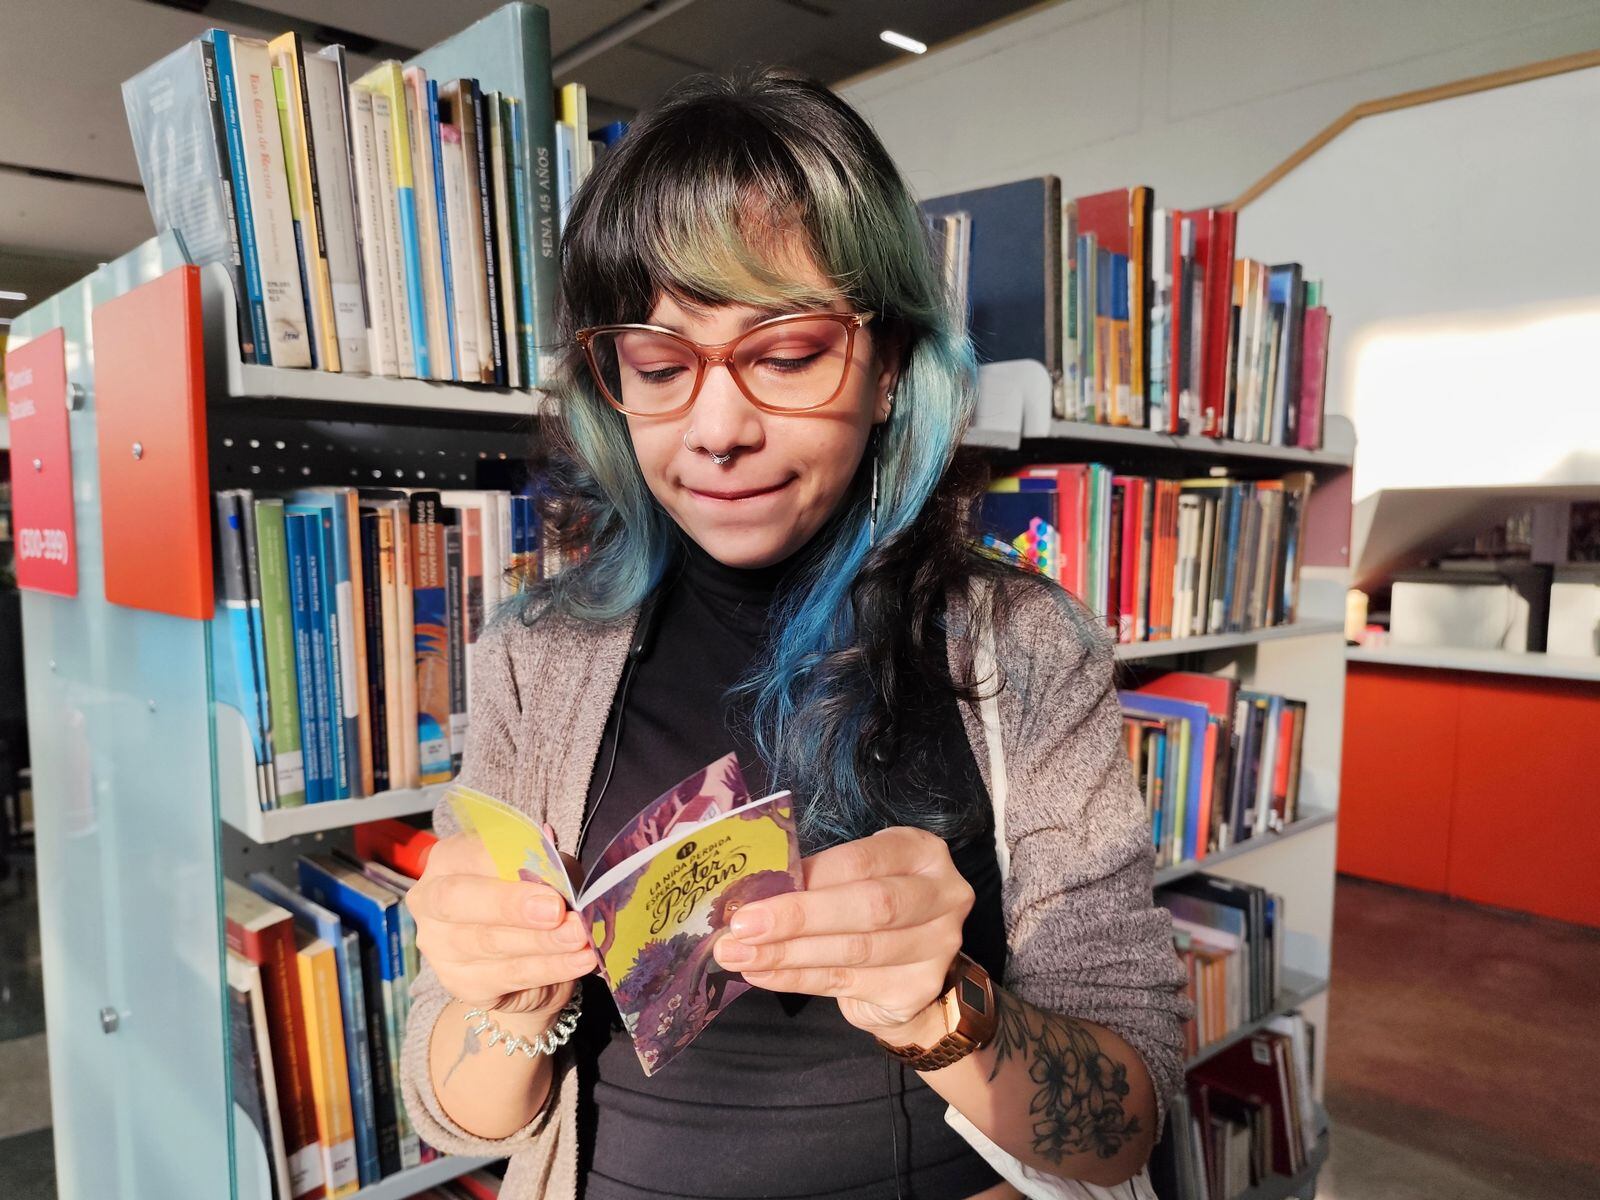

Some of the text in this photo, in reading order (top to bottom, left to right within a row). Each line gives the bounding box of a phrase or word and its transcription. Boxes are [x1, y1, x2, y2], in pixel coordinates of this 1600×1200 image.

[535, 147, 552, 257] SENA 45 AÑOS
[419, 555, 429, 586] VOCES
[426, 500, 438, 586] UNIVERSITARIAS
[646, 849, 720, 911] ESPERA A
[650, 835, 731, 895] LA NIÑA PERDIDA
[650, 856, 726, 934] Peter
[677, 853, 746, 922] Pan
